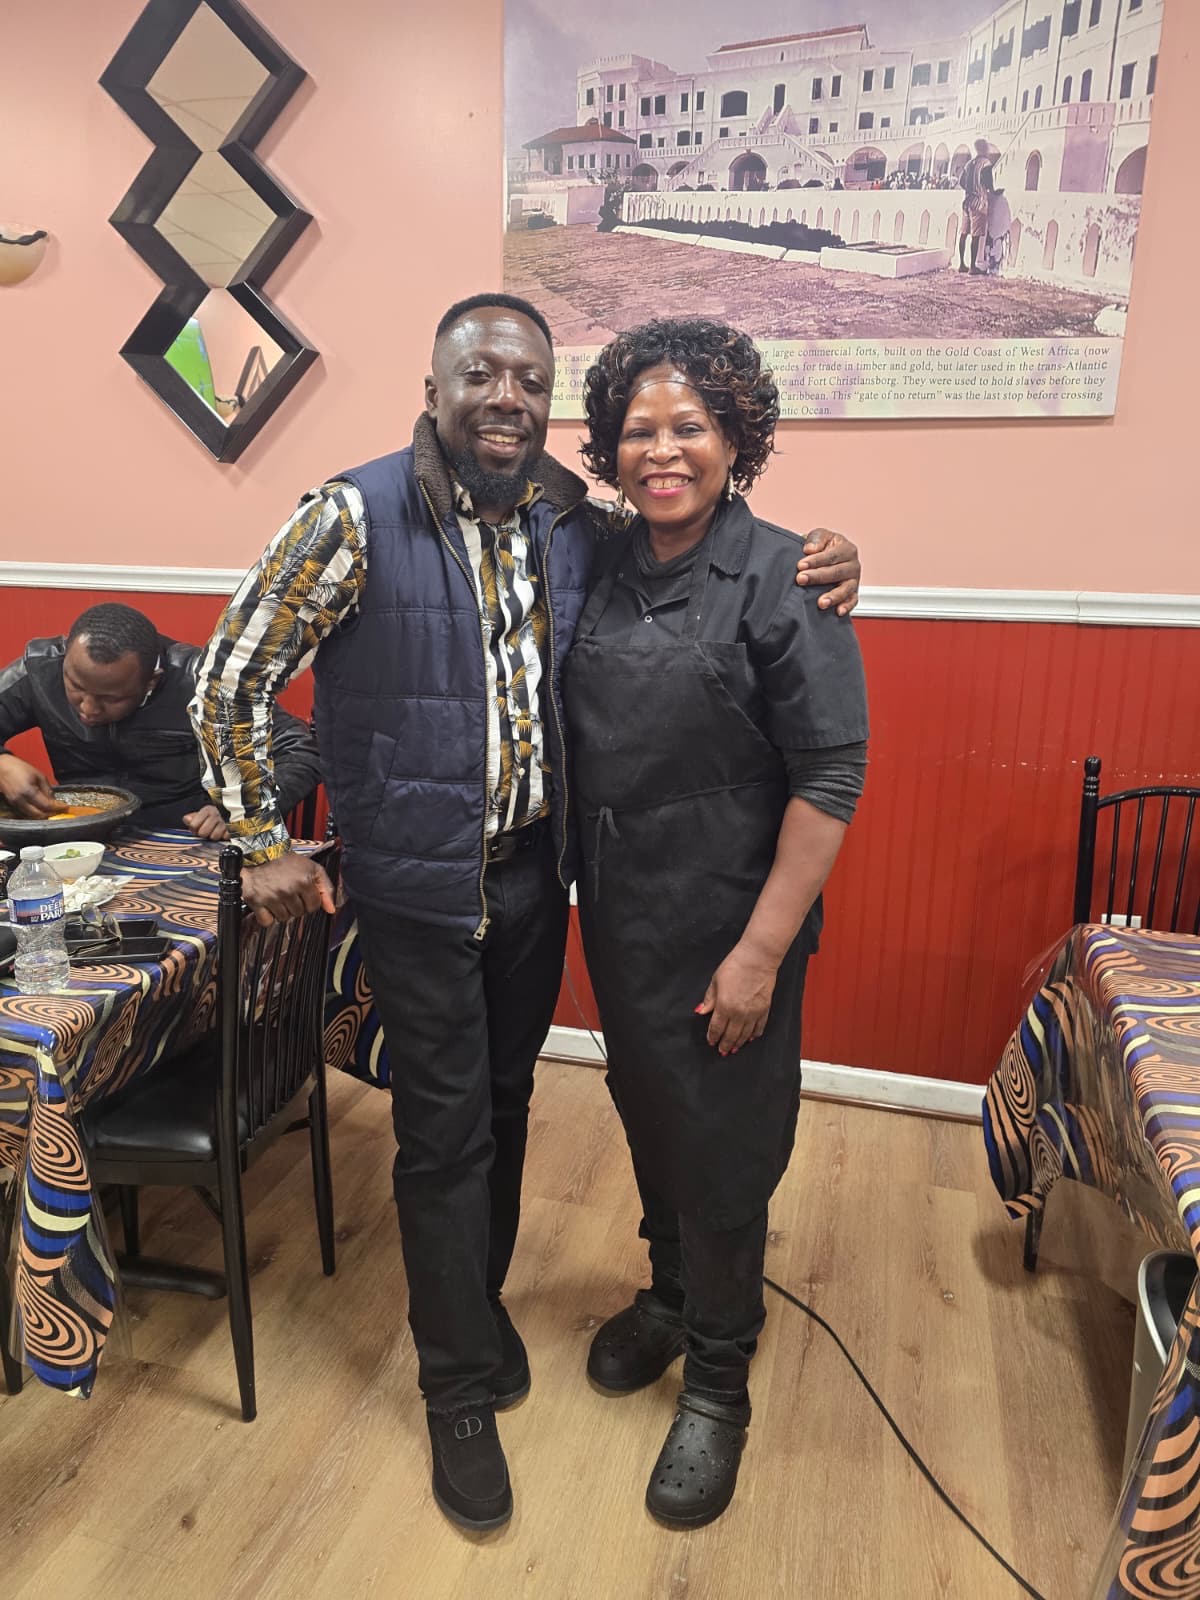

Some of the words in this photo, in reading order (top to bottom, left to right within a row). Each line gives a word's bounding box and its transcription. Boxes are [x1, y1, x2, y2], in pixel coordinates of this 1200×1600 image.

[565, 353, 591, 362] Castle
[772, 347, 794, 359] large
[798, 346, 851, 357] commercial
[856, 346, 879, 358] forts,
[885, 345, 906, 357] built
[910, 348, 922, 356] on
[926, 346, 941, 356] the
[945, 346, 970, 356] Gold
[973, 346, 1001, 356] Coast
[1006, 346, 1018, 357] of
[1021, 346, 1045, 356] West
[1048, 345, 1080, 356] Africa
[1084, 345, 1110, 357] (now
[766, 361, 799, 372] Swedes
[803, 361, 818, 371] for
[819, 361, 841, 371] trade
[845, 361, 855, 371] in
[857, 360, 887, 371] timber
[890, 361, 907, 371] and
[910, 361, 934, 373] gold,
[937, 361, 952, 371] but
[956, 361, 977, 371] later
[981, 361, 1003, 371] used
[1007, 361, 1016, 371] in
[1019, 361, 1034, 371] the
[1037, 360, 1108, 371] trans-Atlantic
[789, 375, 805, 386] and
[808, 376, 826, 386] Fort
[829, 375, 899, 388] Christiansborg.
[902, 375, 926, 387] They
[929, 378, 952, 386] were
[955, 375, 977, 386] used
[980, 375, 989, 386] to
[992, 375, 1013, 386] hold
[1016, 375, 1046, 386] slaves
[1049, 375, 1081, 386] before
[1084, 375, 1106, 387] they
[780, 390, 829, 401] Caribbean.
[832, 390, 852, 400] This
[881, 390, 893, 400] of
[893, 392, 905, 400] no
[945, 391, 962, 400] was
[965, 390, 981, 400] the
[983, 389, 1001, 400] last
[1003, 391, 1024, 402] stop
[1026, 389, 1058, 400] before
[1061, 389, 1103, 402] crossing
[781, 405, 798, 415] ntic
[801, 404, 832, 415] Ocean.
